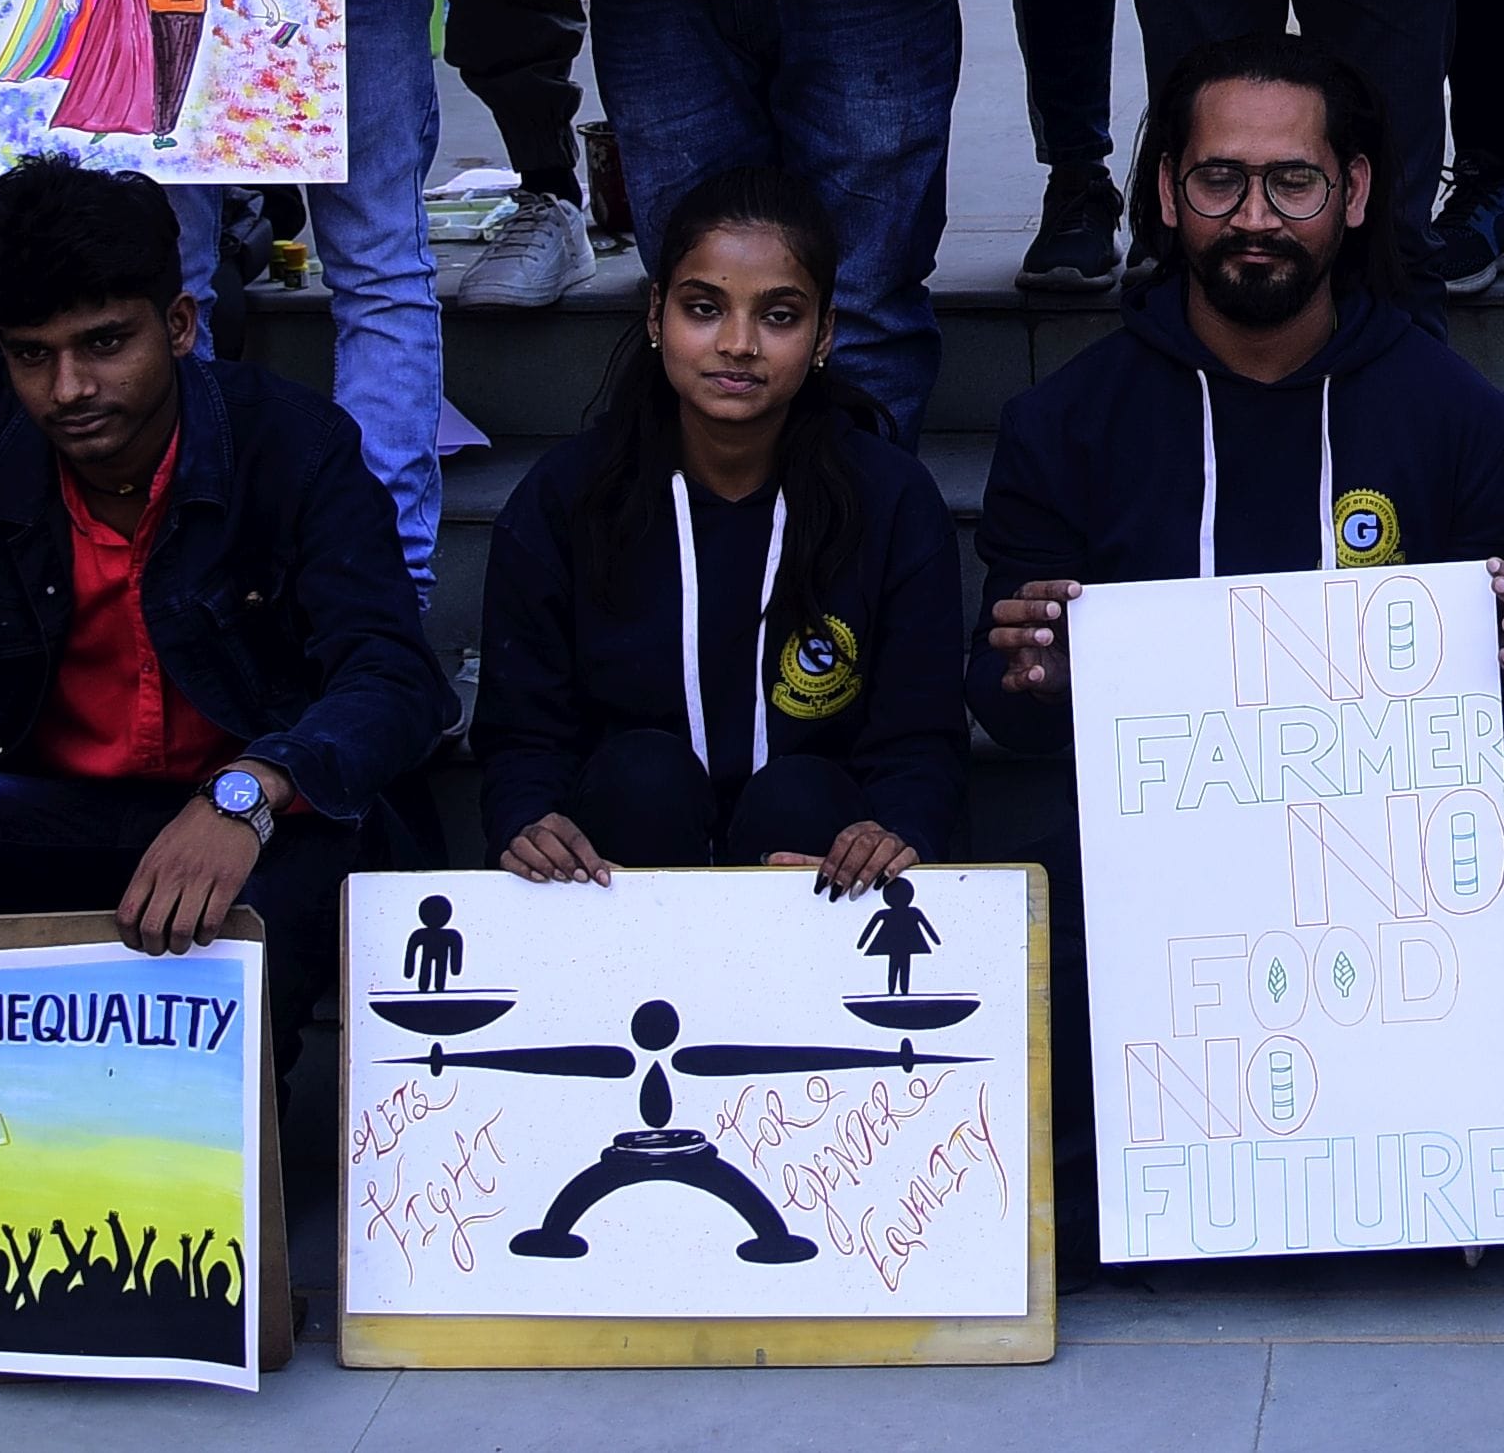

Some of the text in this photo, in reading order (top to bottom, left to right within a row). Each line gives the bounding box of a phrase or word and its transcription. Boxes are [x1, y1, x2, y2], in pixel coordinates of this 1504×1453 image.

[1343, 513, 1378, 548] G
[1228, 575, 1443, 707] NO
[1115, 693, 1504, 816] FARMER
[1167, 918, 1460, 1038] FOOD
[1124, 1034, 1318, 1143] NO
